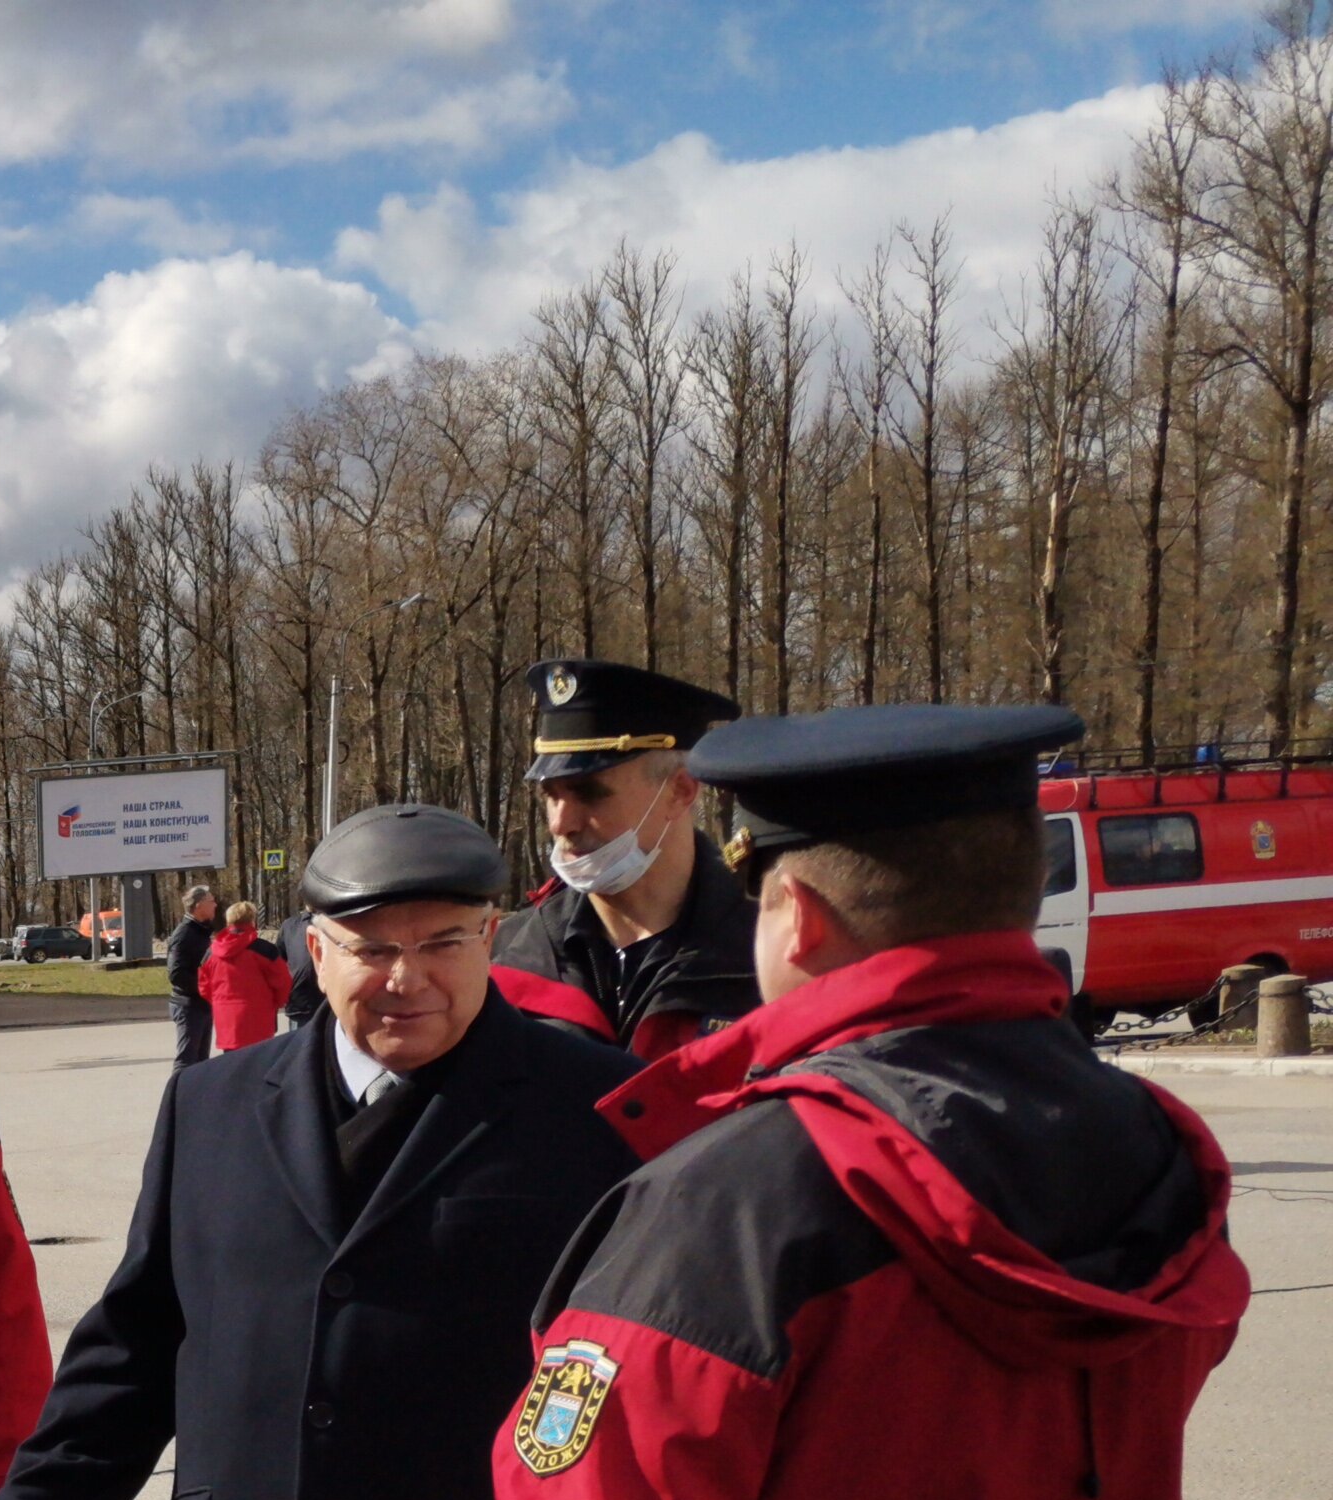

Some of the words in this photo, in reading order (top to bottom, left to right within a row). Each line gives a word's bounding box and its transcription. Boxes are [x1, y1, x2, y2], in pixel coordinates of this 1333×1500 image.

[123, 802, 147, 812] НАША
[149, 800, 183, 811] СТРАНА,
[123, 818, 147, 829] НАША
[123, 835, 147, 845] НАШЕ
[149, 832, 189, 844] РЕШЕНИЕ!
[518, 1373, 604, 1469] ЛЕНОБЛПОЖСПАС
